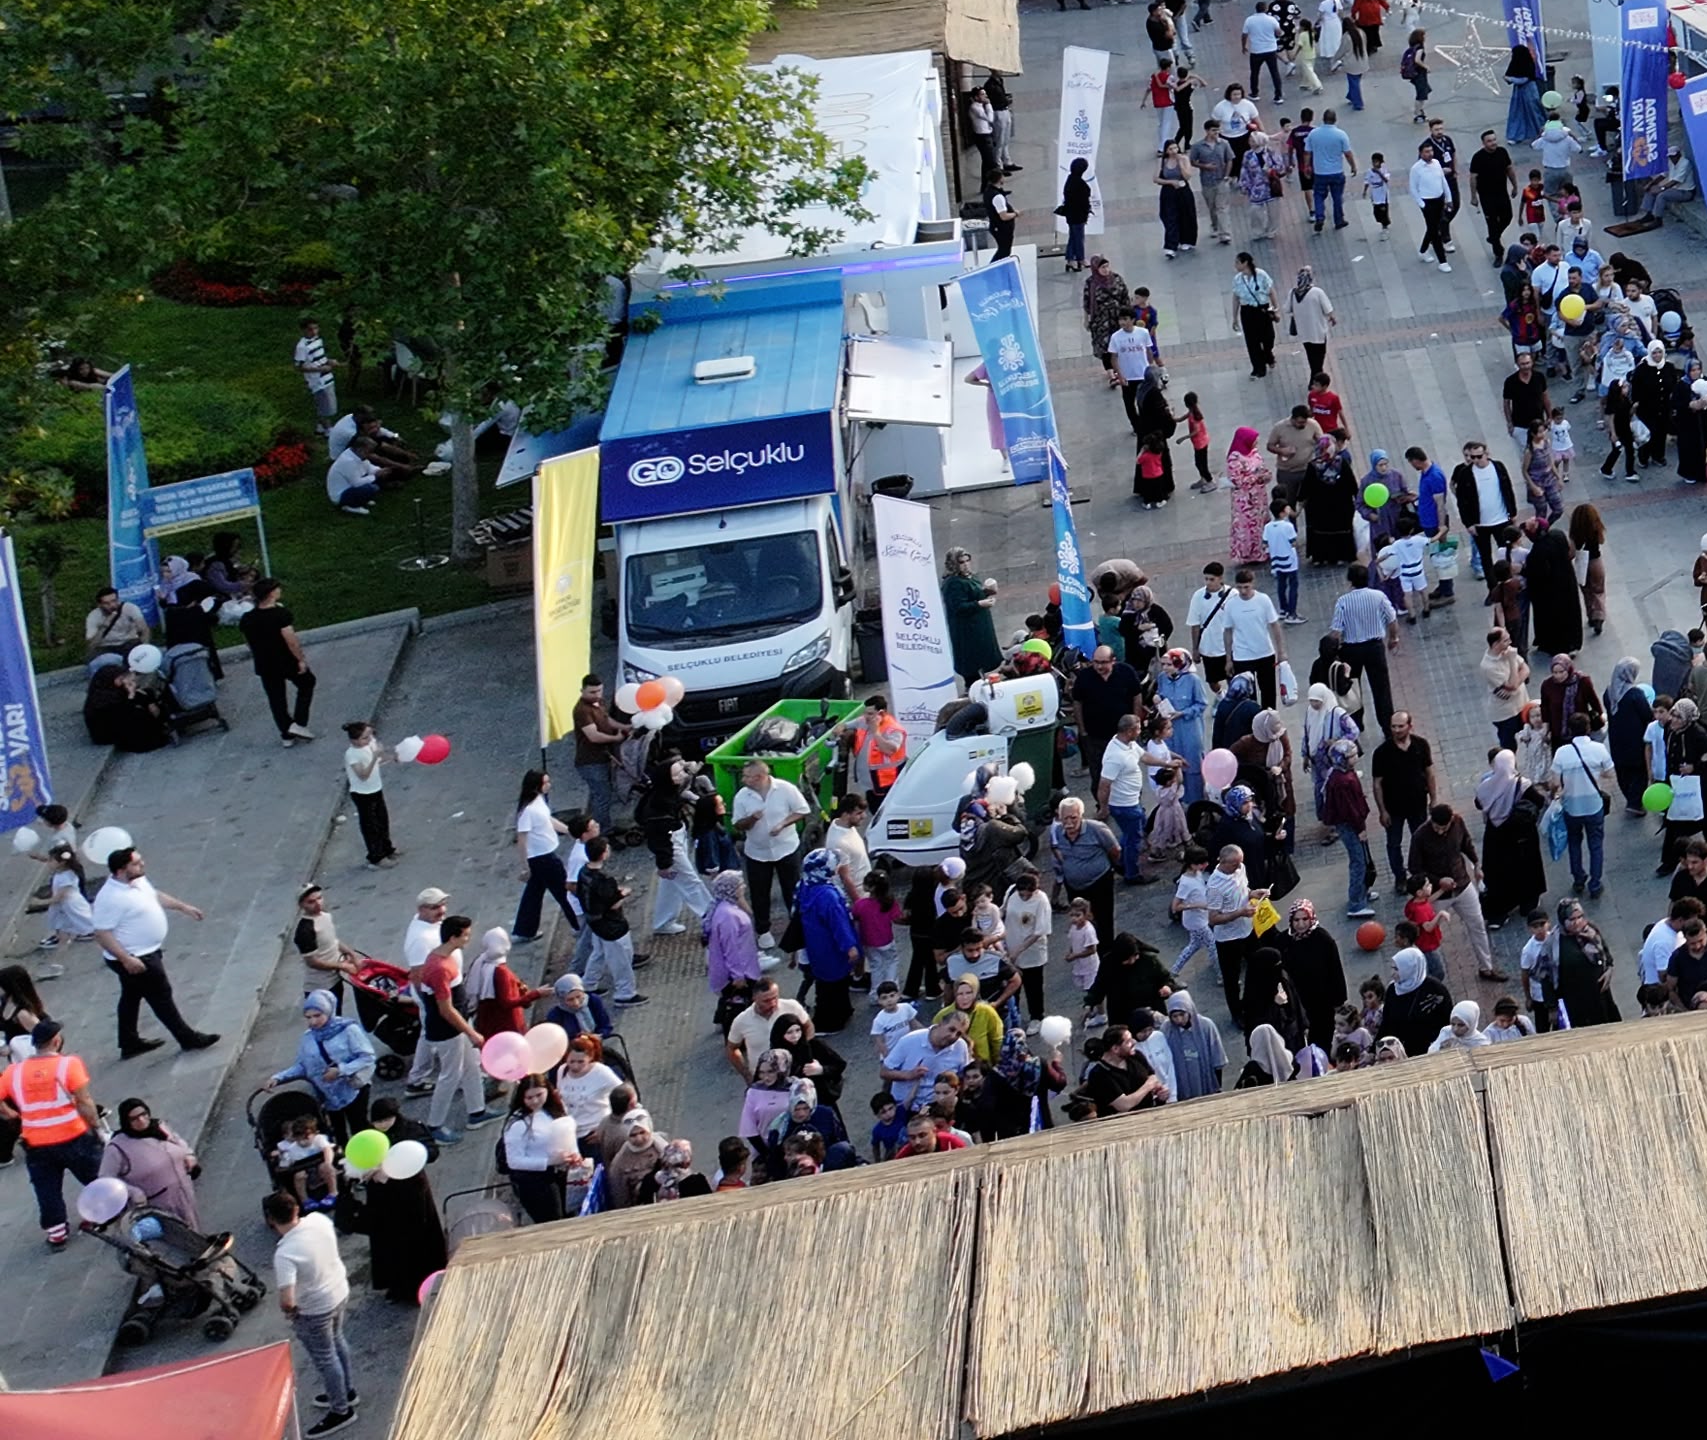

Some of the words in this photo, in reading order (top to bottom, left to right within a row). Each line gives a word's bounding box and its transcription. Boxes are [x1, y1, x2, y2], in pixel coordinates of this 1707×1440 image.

[633, 460, 680, 482] GO
[689, 442, 804, 475] Selçuklu
[896, 632, 942, 646] SELÇUKLU
[667, 658, 721, 672] SELÇUKLU
[724, 648, 783, 663] BELEDİYESİ
[718, 697, 738, 712] FIAT
[4, 703, 31, 757] VAR!
